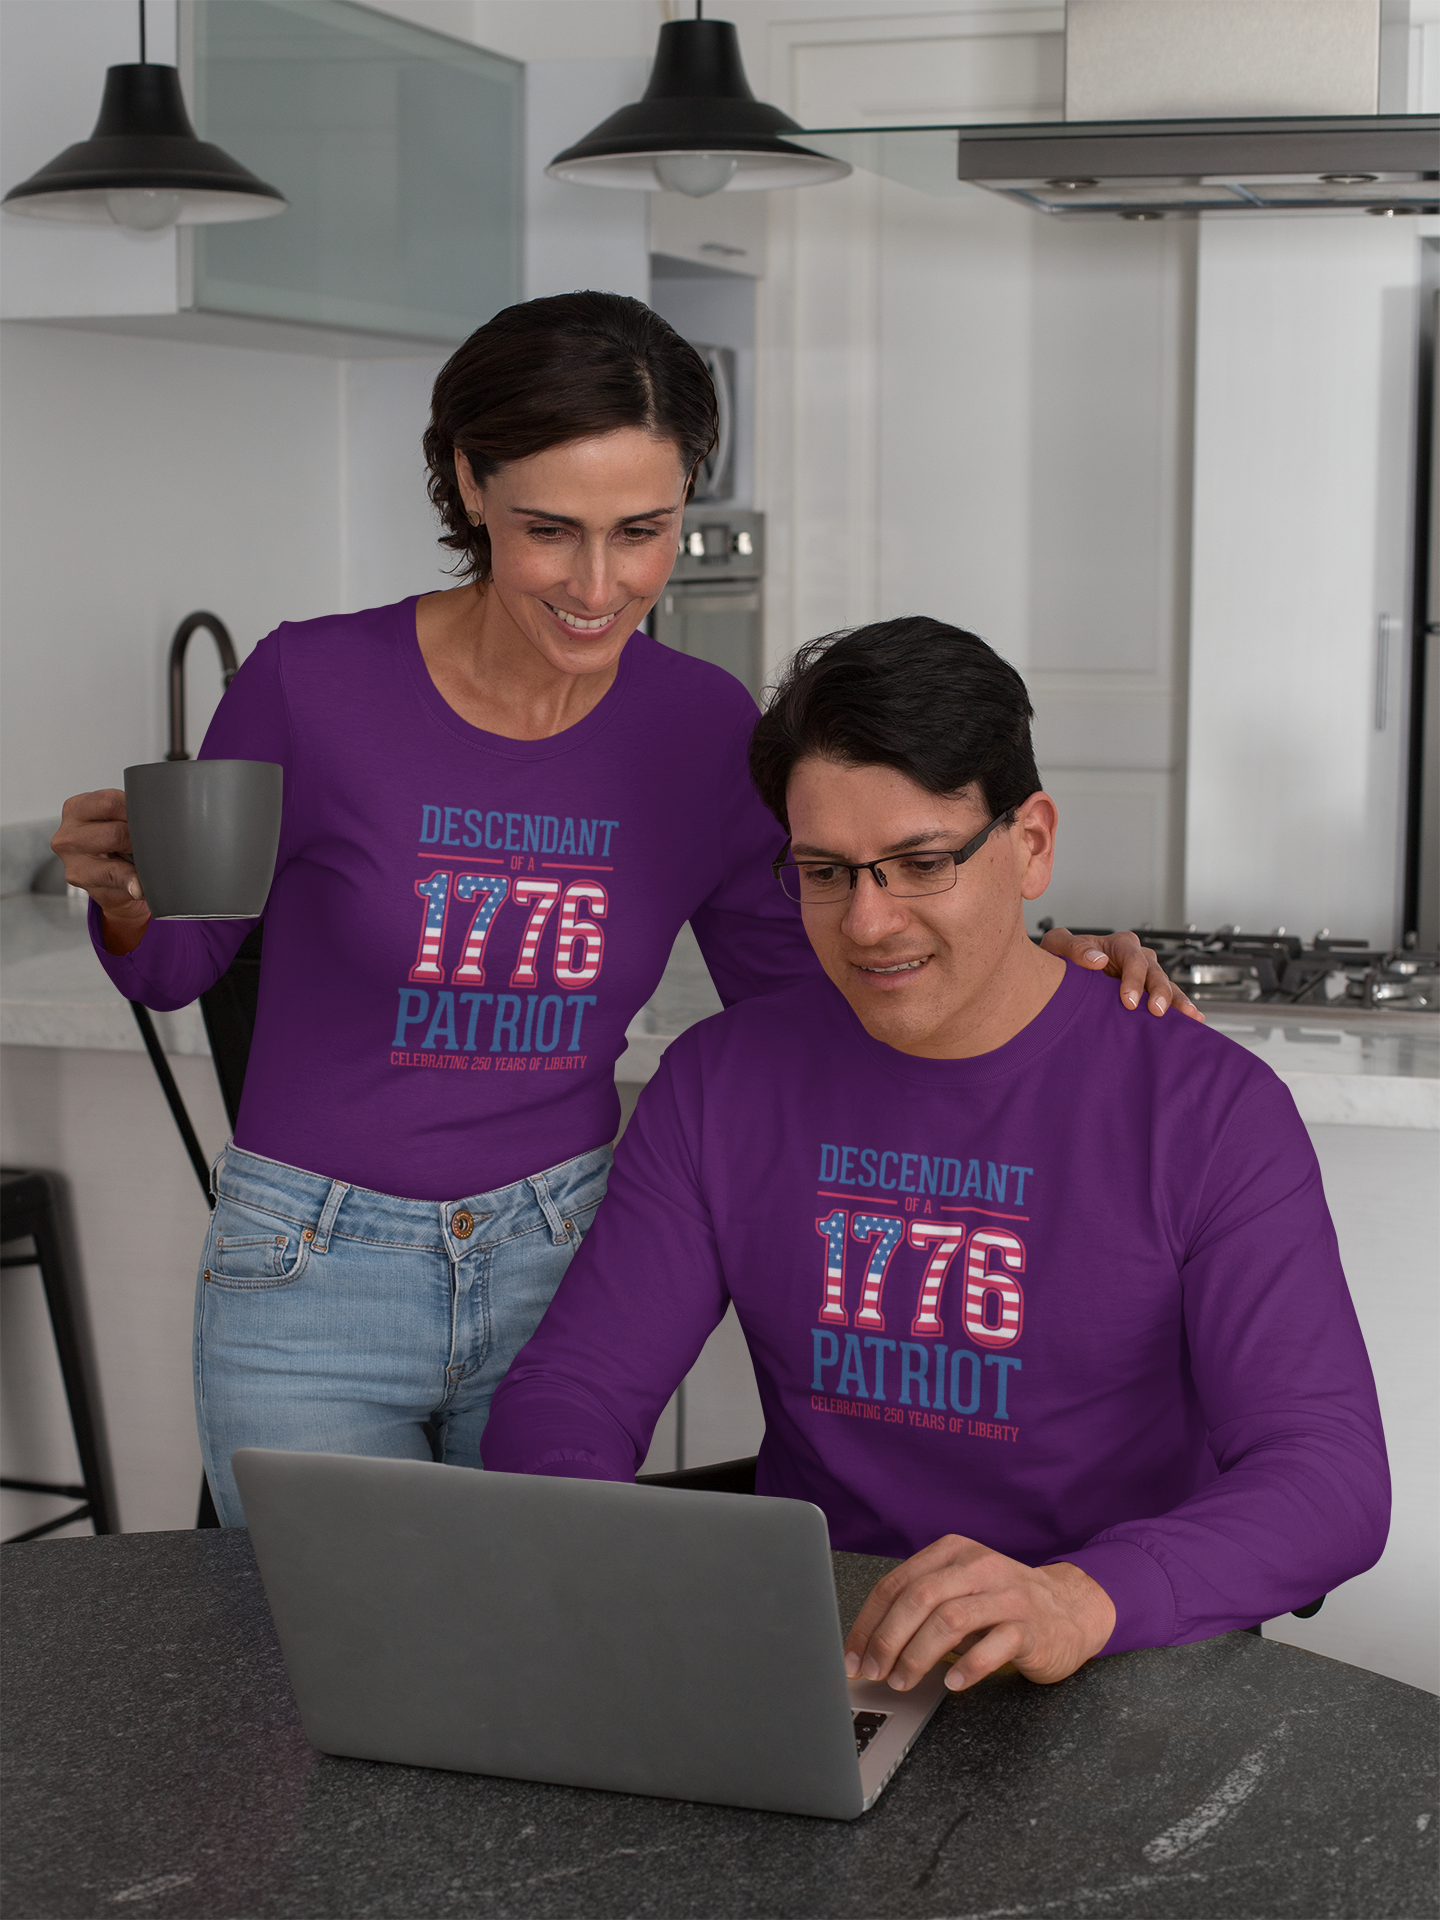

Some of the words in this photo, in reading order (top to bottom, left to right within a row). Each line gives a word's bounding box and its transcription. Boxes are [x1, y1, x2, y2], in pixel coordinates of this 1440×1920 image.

[419, 804, 619, 857] DESCENDANT
[510, 856, 524, 870] OF
[527, 857, 535, 871] A
[408, 870, 609, 990] 1776
[391, 988, 597, 1053] PATRIOT
[390, 1051, 469, 1070] CELEBRATING
[470, 1056, 491, 1071] 250
[494, 1057, 527, 1071] YEARS
[529, 1057, 543, 1071] OF
[544, 1055, 587, 1070] LIBERTY
[818, 1143, 1034, 1206] DESCENDANT
[904, 1197, 920, 1212] OF
[923, 1199, 932, 1214] A
[815, 1208, 1026, 1349] 1776
[811, 1328, 1022, 1420] PATRIOT
[811, 1395, 880, 1420] CELEBRATING
[884, 1407, 904, 1424] 250
[908, 1410, 945, 1430] YEARS
[949, 1417, 964, 1433] OF
[968, 1420, 1019, 1443] LIBERTY
